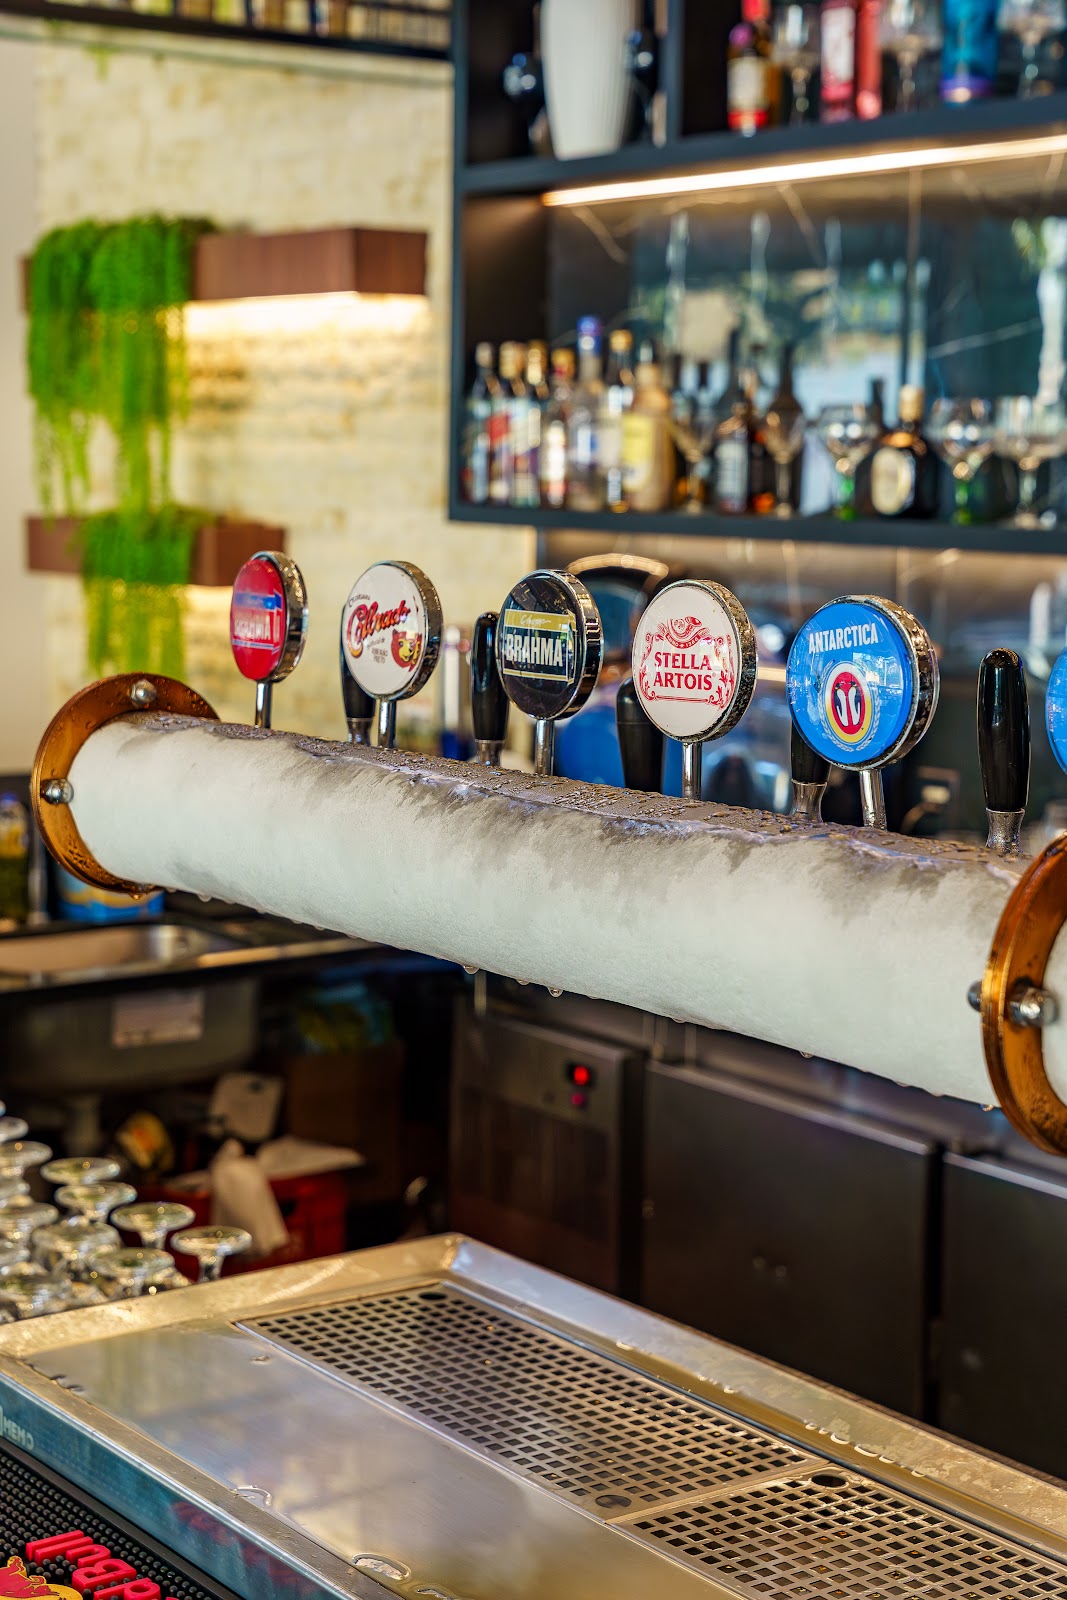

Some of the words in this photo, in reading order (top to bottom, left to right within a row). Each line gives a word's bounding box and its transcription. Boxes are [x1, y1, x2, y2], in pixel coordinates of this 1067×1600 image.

[506, 634, 563, 667] BRAHMA
[809, 623, 878, 654] ANTARCTICA
[654, 651, 712, 671] STELLA
[653, 671, 713, 691] ARTOIS
[26, 1530, 137, 1596] Bull
